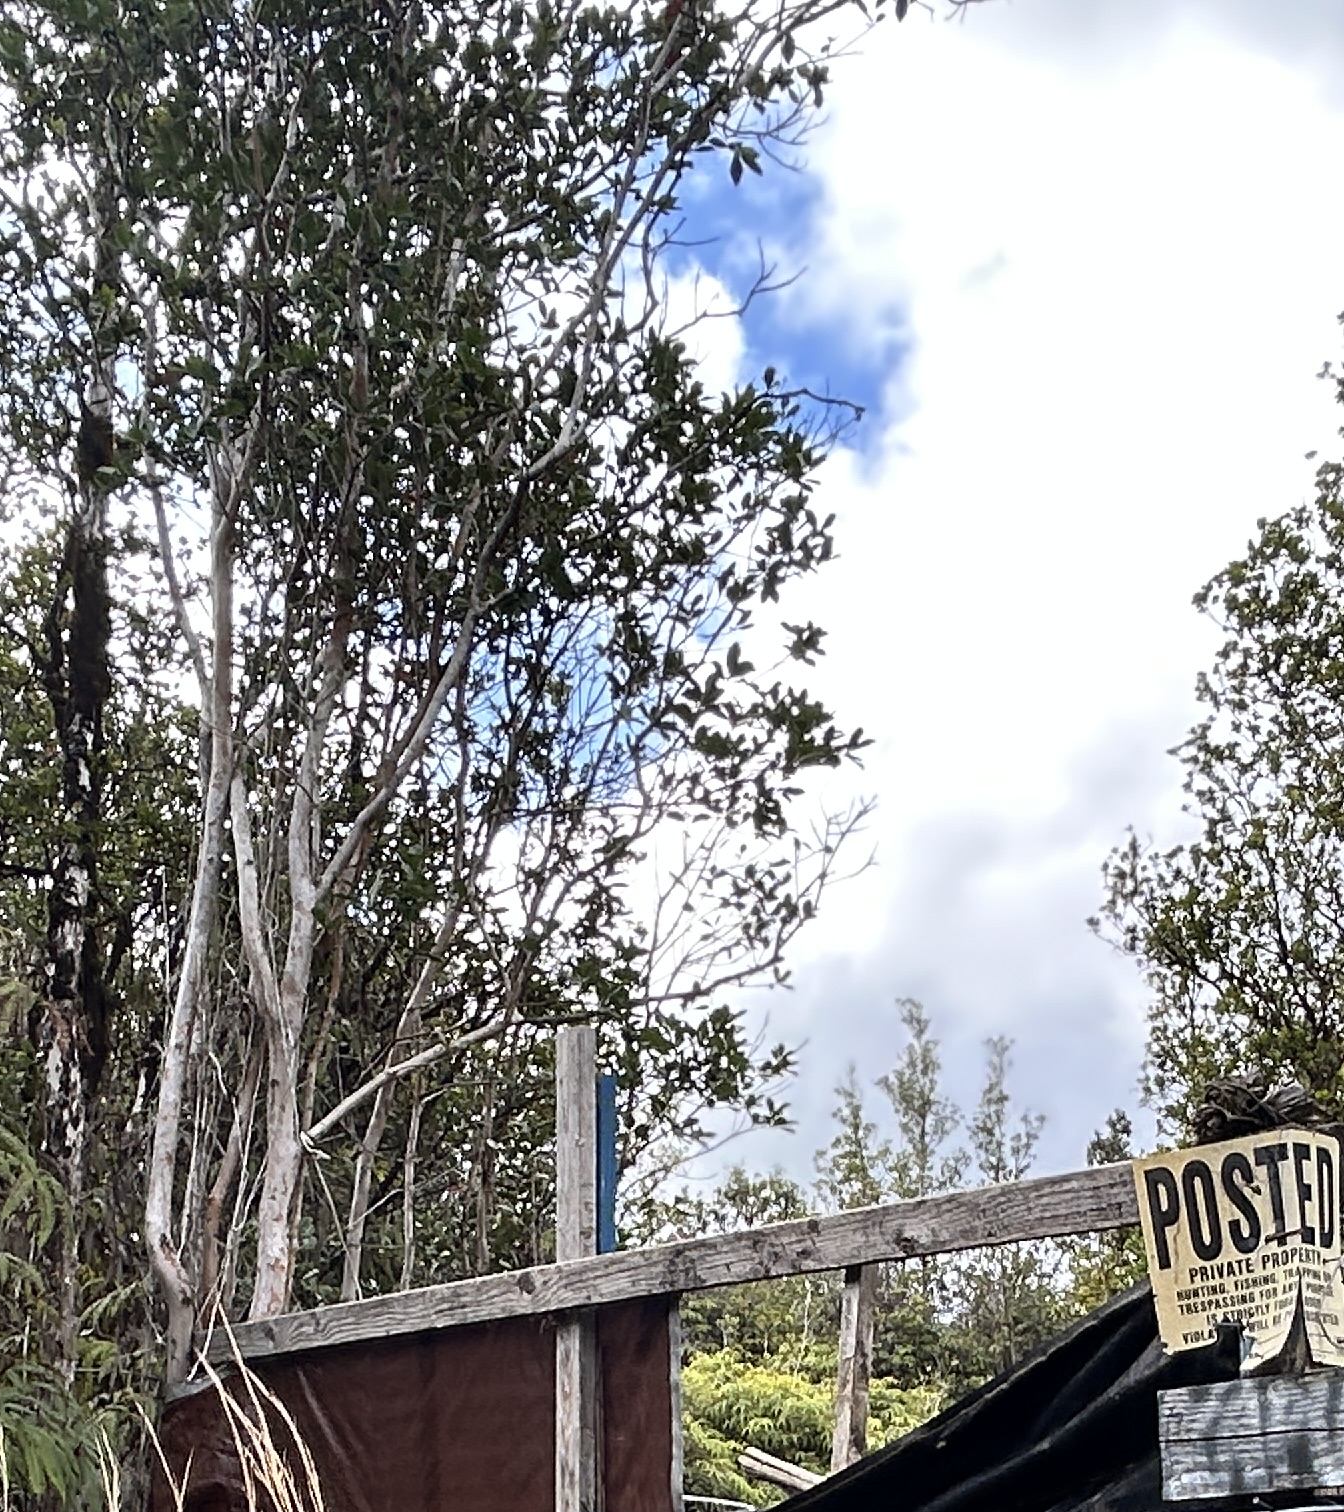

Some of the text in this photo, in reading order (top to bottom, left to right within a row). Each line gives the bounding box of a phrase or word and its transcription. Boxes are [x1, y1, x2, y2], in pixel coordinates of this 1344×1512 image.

[1144, 1142, 1335, 1270] POSTED
[1188, 1246, 1321, 1284] PRIVATE PROPERTY
[1177, 1292, 1255, 1316] TRESPASSING
[1182, 1329, 1215, 1345] VIOLA
